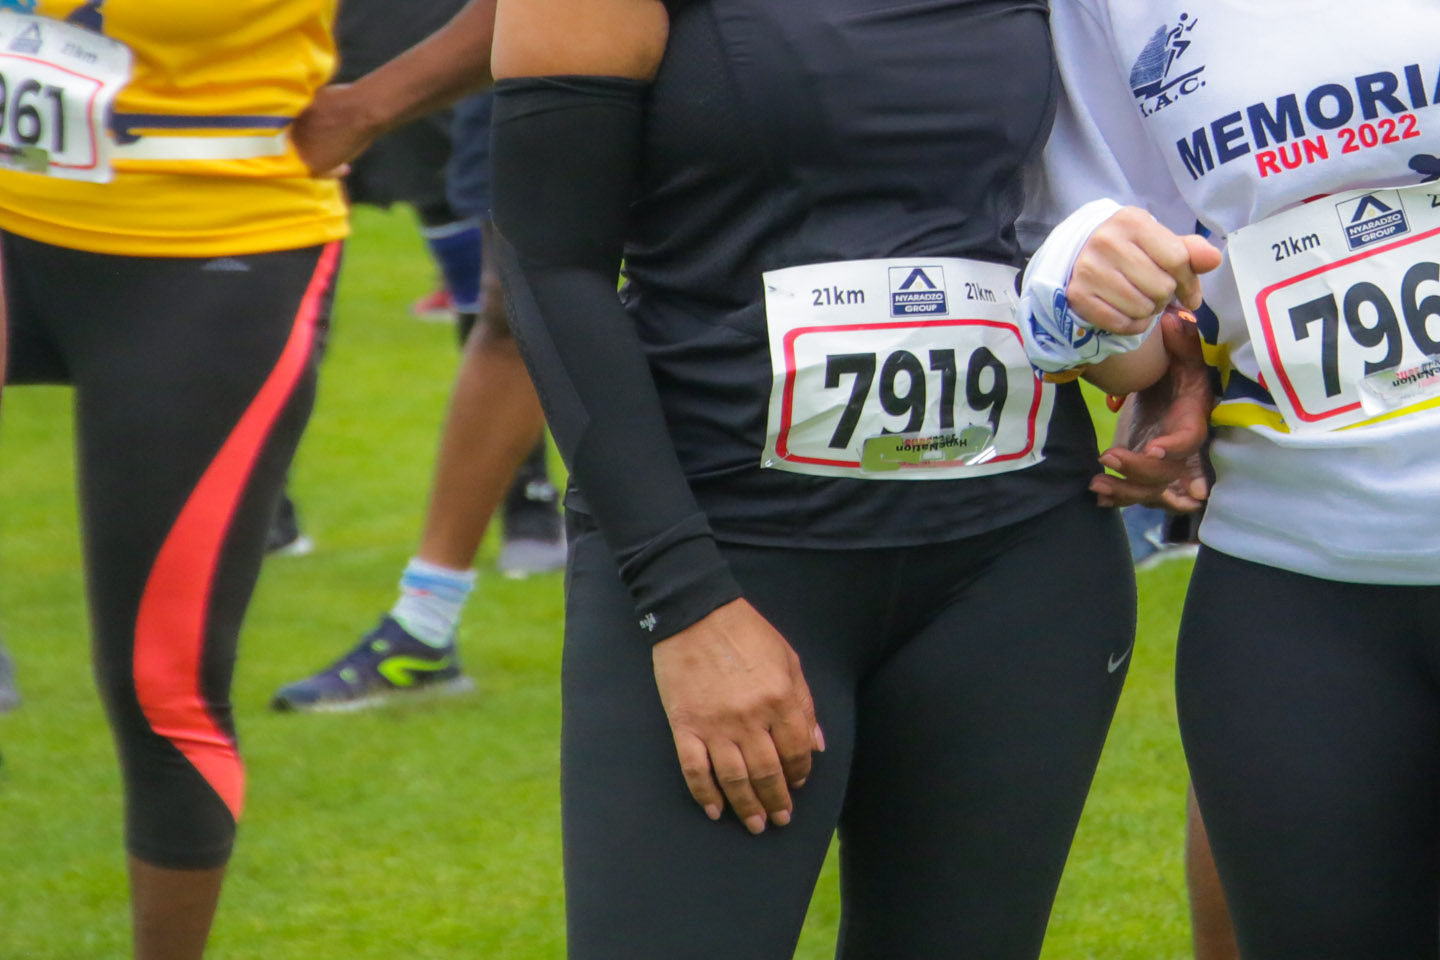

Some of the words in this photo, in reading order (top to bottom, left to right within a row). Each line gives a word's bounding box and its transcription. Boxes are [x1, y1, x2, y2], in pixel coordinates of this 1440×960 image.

[1255, 133, 1329, 178] RUN
[1338, 113, 1421, 154] 2022
[1349, 213, 1401, 235] NYARADZO
[1361, 226, 1396, 242] GROUP
[1272, 231, 1321, 262] 21km
[812, 286, 865, 306] 21km
[895, 292, 944, 303] NYARADZO
[965, 282, 996, 303] 21km
[904, 304, 937, 313] GROUP
[824, 346, 1009, 449] 7919
